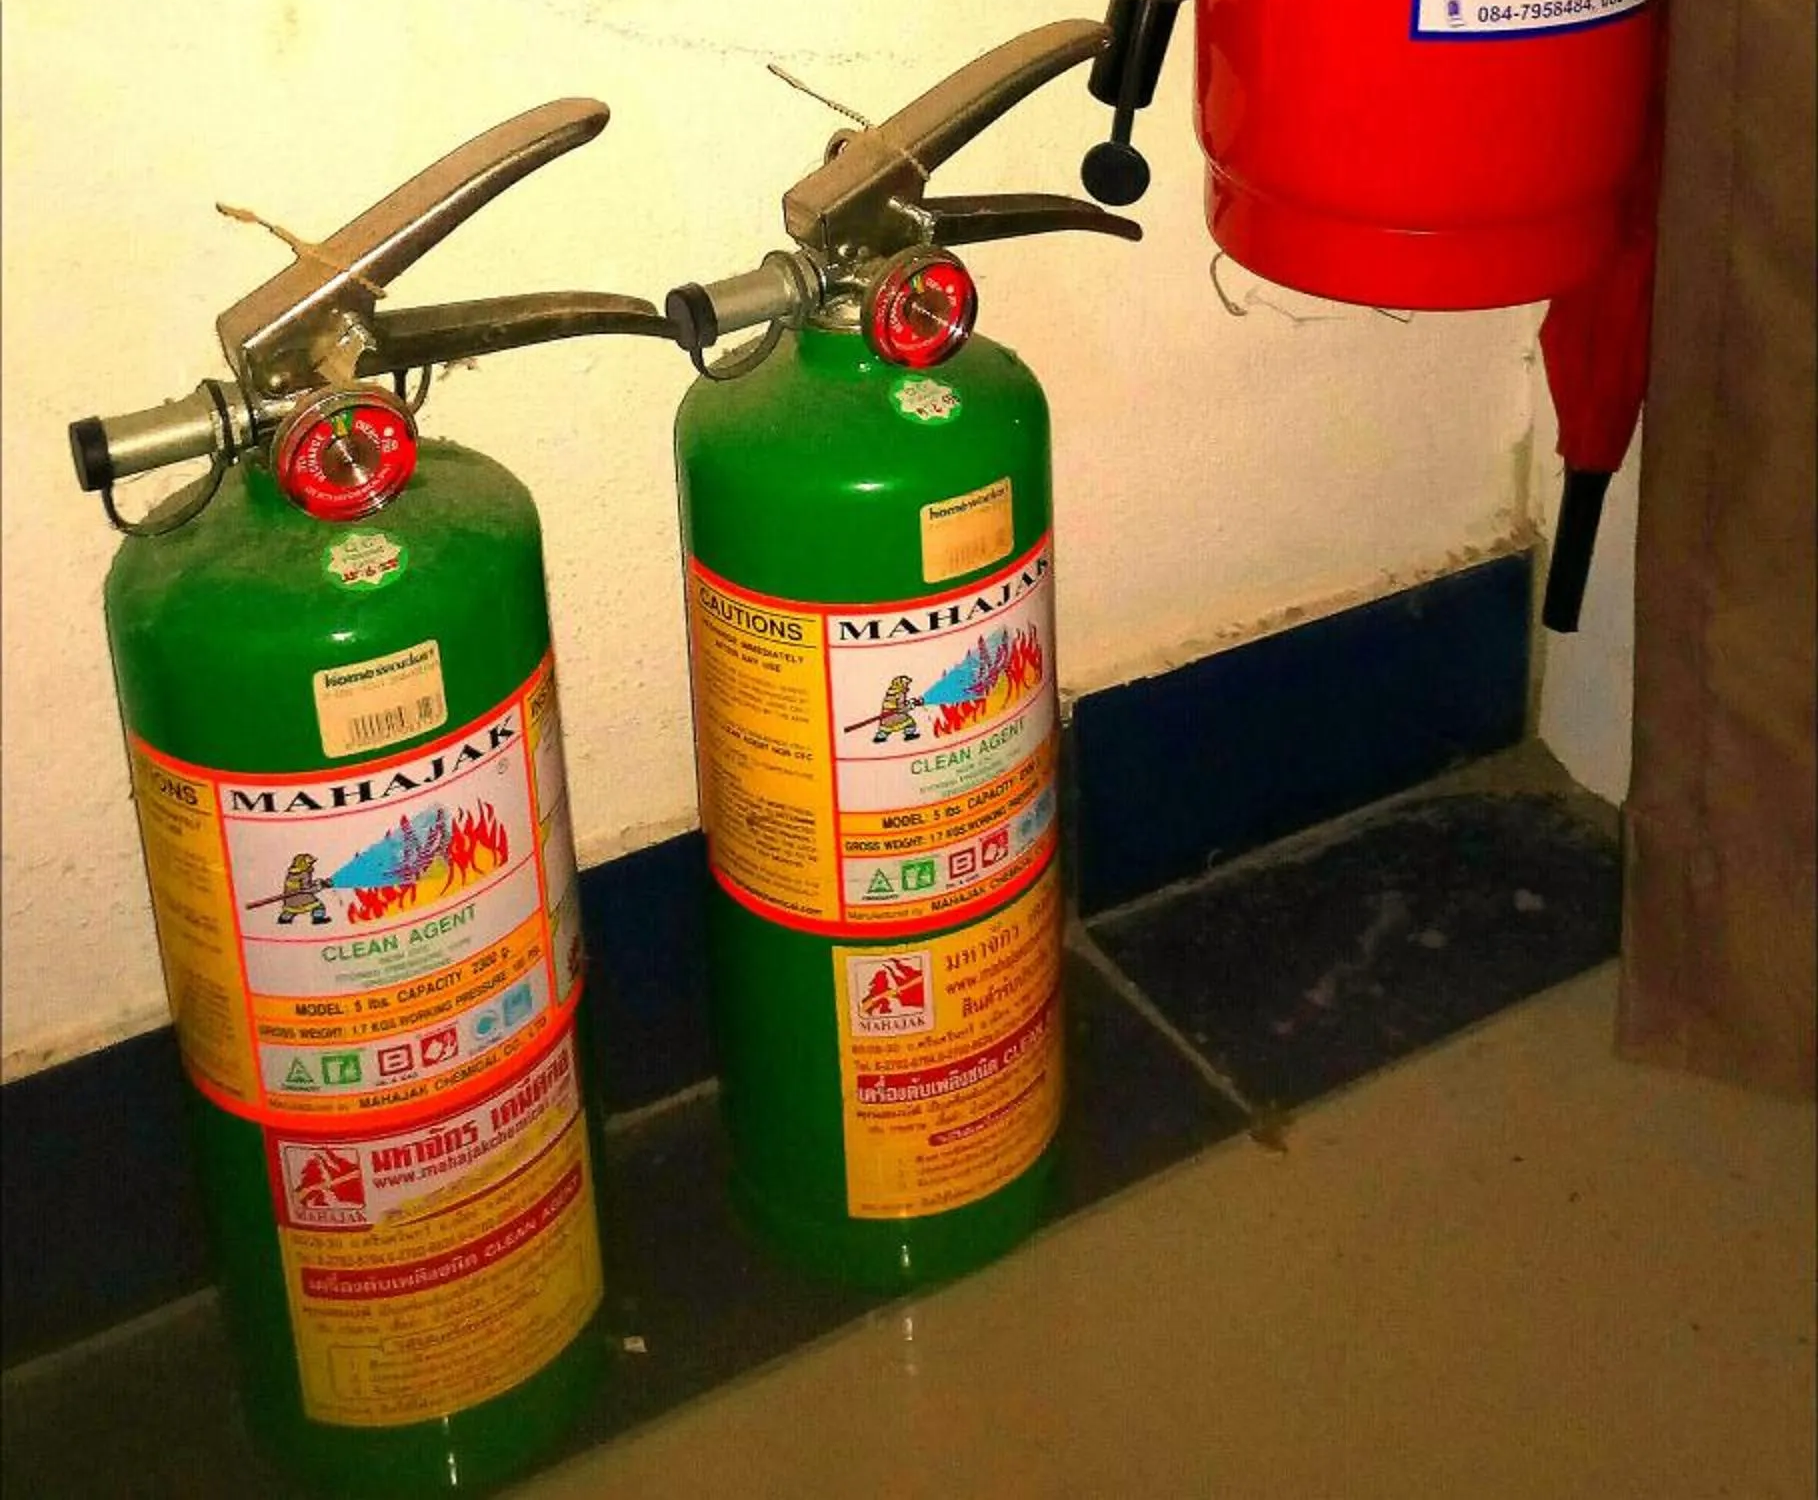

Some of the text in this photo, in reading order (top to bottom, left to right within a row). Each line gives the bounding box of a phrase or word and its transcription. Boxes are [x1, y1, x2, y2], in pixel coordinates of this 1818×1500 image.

[700, 587, 803, 641] CAUTIONS
[838, 556, 1050, 641] MAHAJAK
[229, 714, 516, 813] MAHAJAK
[911, 716, 1025, 776] CLEAN AGENT
[933, 810, 941, 821] 5
[967, 778, 1015, 810] CAPACITY
[845, 839, 881, 852] GROSS
[321, 903, 476, 963] CLEAN AGENT
[354, 1001, 362, 1013] 5
[396, 969, 463, 1002] CAPACITY
[859, 1016, 926, 1034] MAHAJAK
[295, 1209, 367, 1224] MAHAJAK
